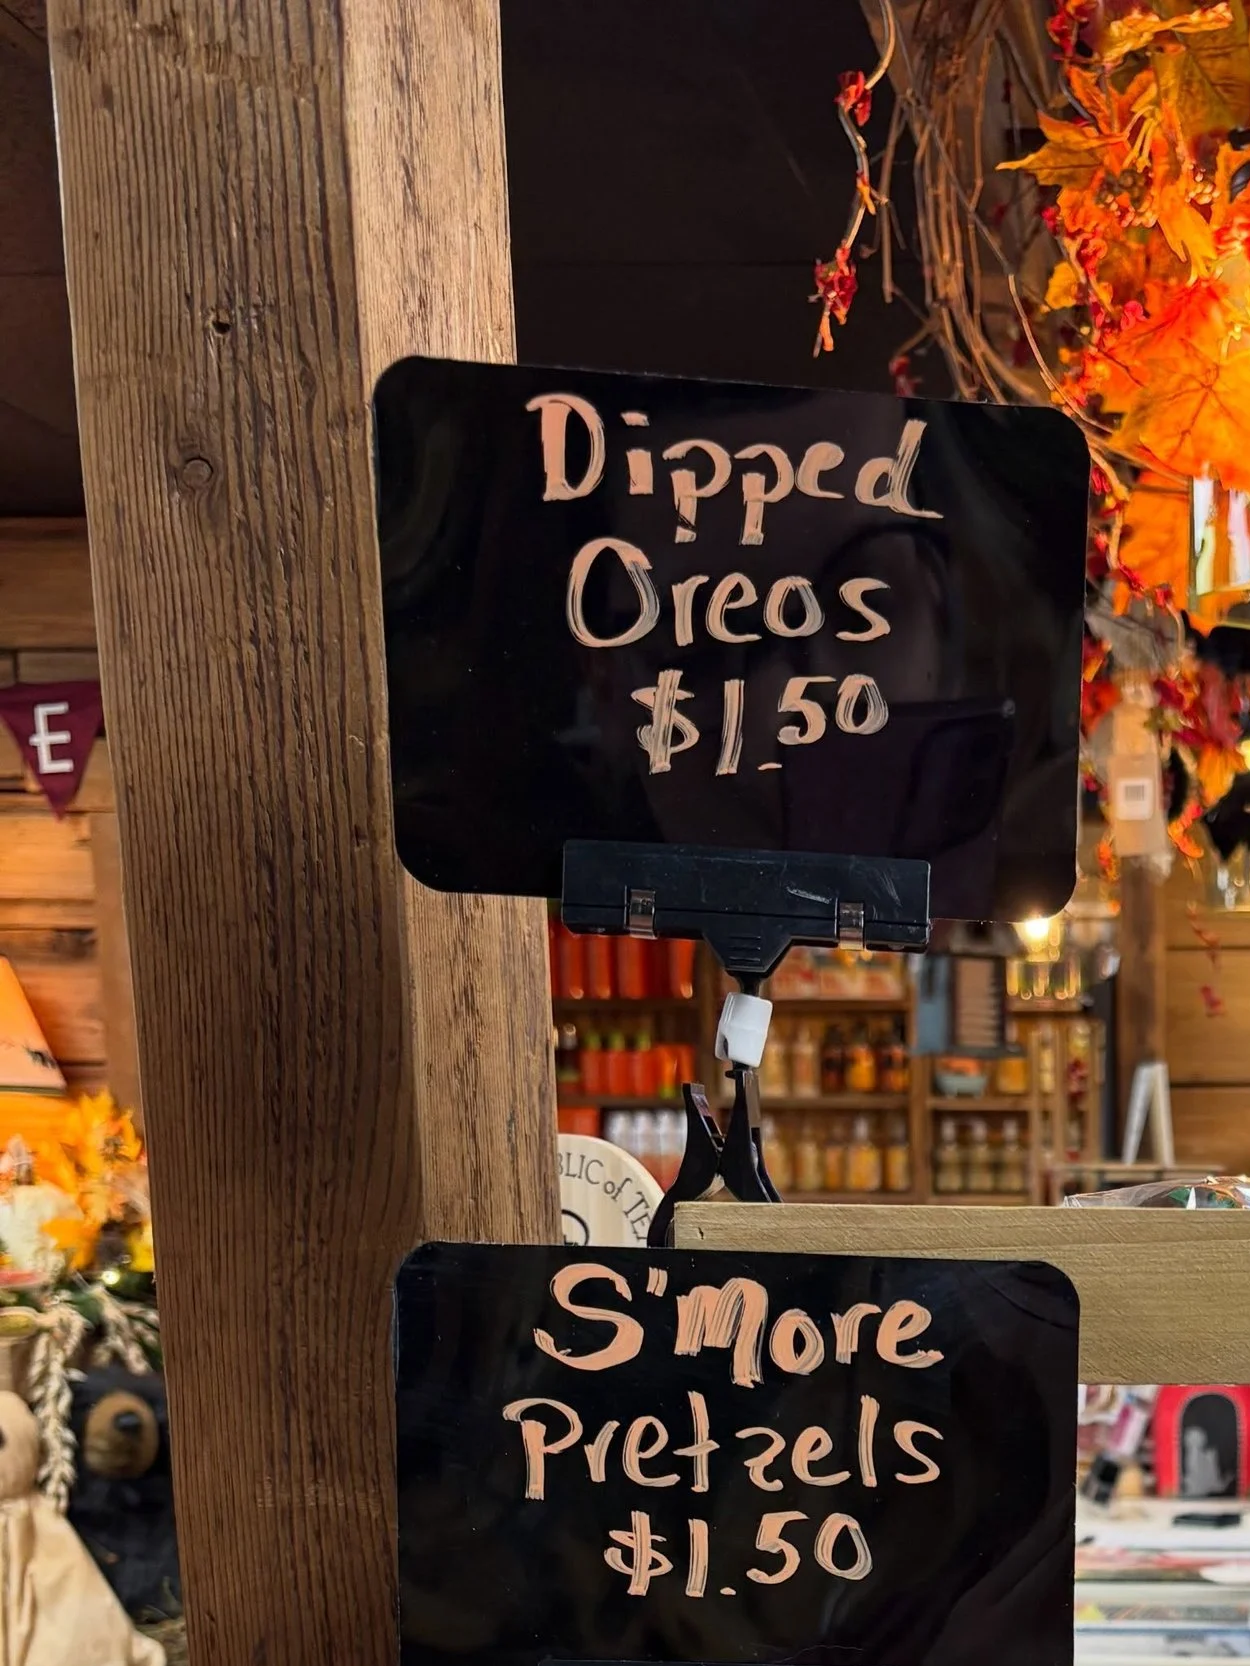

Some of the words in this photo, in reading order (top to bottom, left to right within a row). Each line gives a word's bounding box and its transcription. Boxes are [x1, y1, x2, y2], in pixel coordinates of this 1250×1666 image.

[526, 392, 943, 545] Dipped
[566, 537, 891, 648] Oreos
[29, 701, 74, 774] E
[631, 669, 889, 776] $1.50
[603, 1178, 632, 1201] of
[502, 1391, 944, 1500] Pretzels
[604, 1510, 874, 1598] $1.50
